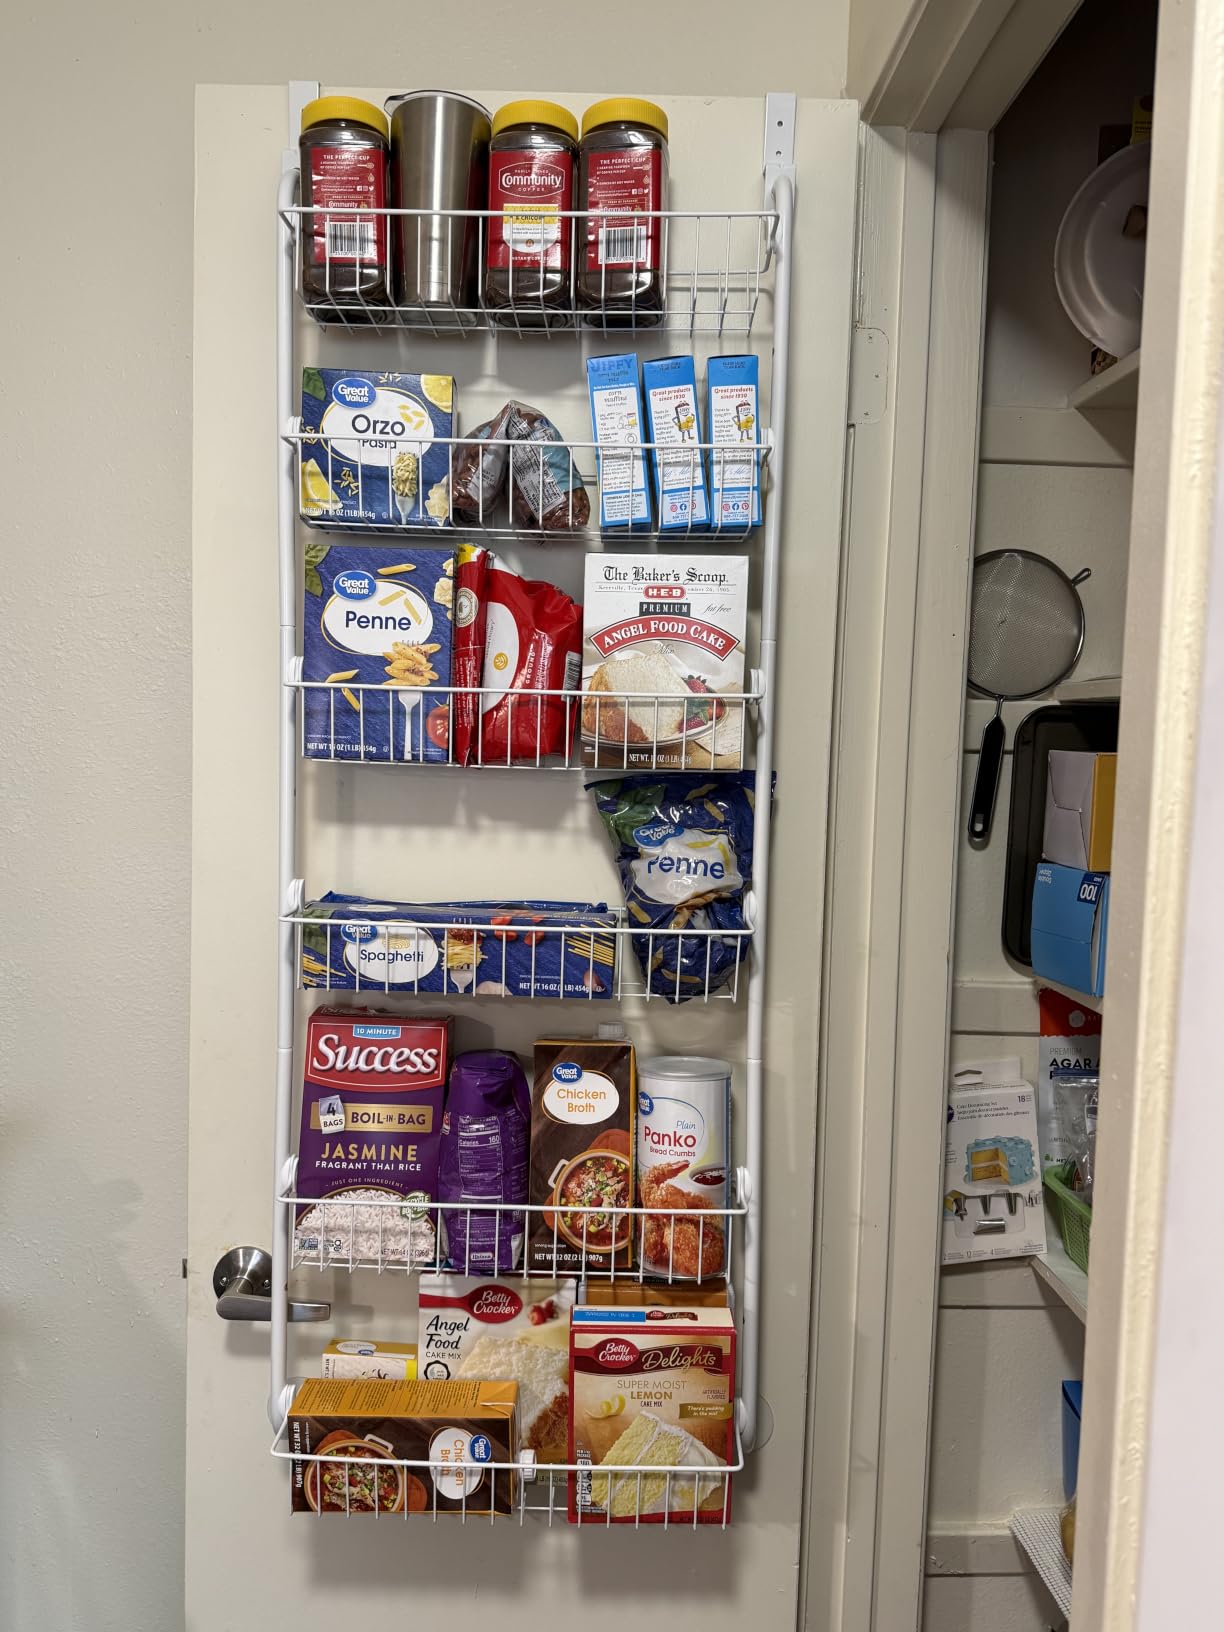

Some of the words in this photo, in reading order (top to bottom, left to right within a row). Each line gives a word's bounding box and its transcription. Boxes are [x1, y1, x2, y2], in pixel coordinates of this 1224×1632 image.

[502, 173, 561, 188] Community
[338, 384, 369, 396] Great
[345, 394, 369, 403] Value
[352, 414, 406, 436] Orzo
[362, 439, 397, 449] Pasta
[603, 566, 628, 581] The
[632, 566, 680, 585] Baker's
[339, 577, 369, 588] Great
[346, 586, 369, 594] Value
[642, 604, 688, 613] PREMIUM
[346, 610, 411, 631] Penne
[604, 624, 648, 648] ANGEL
[650, 621, 687, 634] FOOD
[690, 625, 726, 650] CAKE
[525, 651, 536, 684] GROUND
[629, 753, 640, 762] NET
[649, 828, 675, 840] Value
[1080, 884, 1098, 901] 100
[346, 924, 371, 933] Great
[360, 949, 424, 964] Spaghetti
[312, 1034, 438, 1073] Success
[1050, 1048, 1082, 1056] PREMIUM
[1050, 1058, 1092, 1069] AGAR
[556, 1067, 577, 1075] Great
[557, 1089, 607, 1099] Chicken
[327, 1103, 336, 1116] 4
[567, 1103, 595, 1112] Broth
[323, 1119, 344, 1128] BAGS
[676, 1120, 696, 1130] Plain
[644, 1125, 696, 1148] Panko
[321, 1142, 418, 1161] JASMINE
[650, 1147, 667, 1155] Bread
[669, 1149, 696, 1157] Crumbs
[315, 1161, 367, 1170] FRAGRANT
[372, 1162, 394, 1170] THAI
[398, 1163, 422, 1171] RICE
[331, 1178, 346, 1186] JUST
[364, 1178, 404, 1188] INGREDIENT
[589, 1255, 603, 1263] 907g
[481, 1290, 511, 1307] Betty
[473, 1301, 515, 1314] Crocker
[426, 1315, 470, 1335] Angel
[426, 1334, 461, 1350] Food
[605, 1342, 630, 1356] Betty
[426, 1351, 446, 1359] CAKE
[448, 1352, 462, 1360] MIX
[598, 1350, 634, 1362] Crocker
[642, 1346, 716, 1373] Delights
[617, 1380, 649, 1389] SUPER
[652, 1380, 687, 1389] MOIST
[630, 1391, 673, 1400] LEMON
[294, 1433, 301, 1442] WT
[478, 1439, 486, 1458] Great
